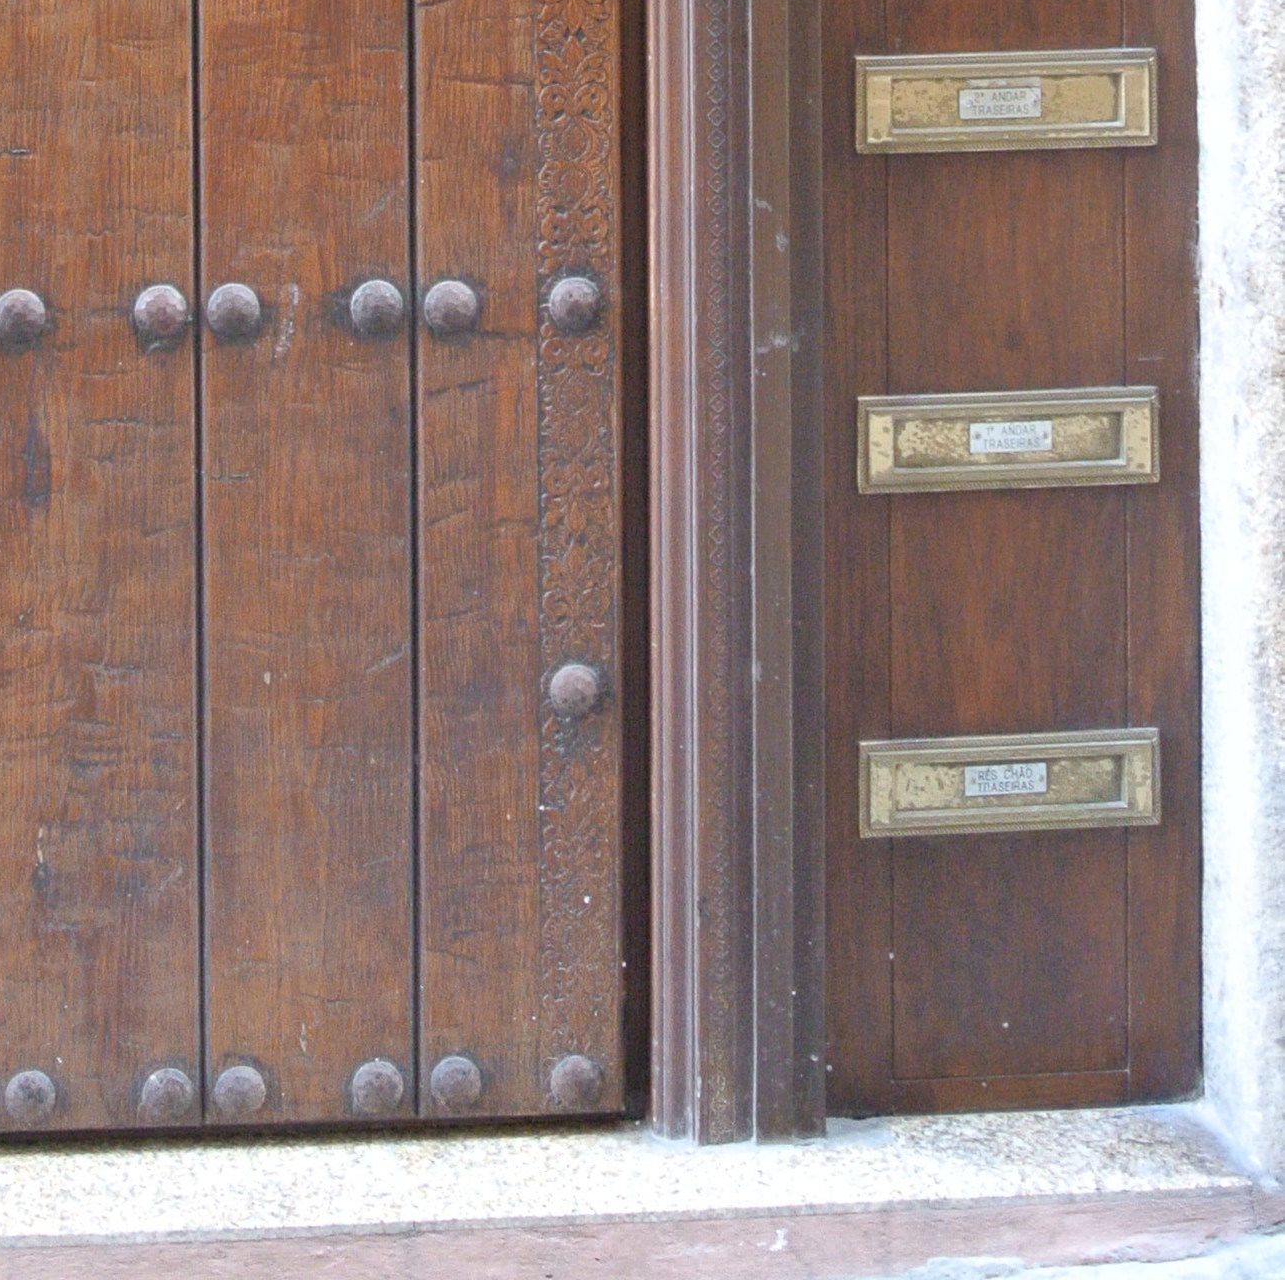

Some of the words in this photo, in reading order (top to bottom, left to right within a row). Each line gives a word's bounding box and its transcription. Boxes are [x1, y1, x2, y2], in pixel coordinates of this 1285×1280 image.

[992, 90, 1027, 102] ANDAR
[971, 104, 1029, 116] TRASEIRAS
[1001, 424, 1036, 435] ANDAR
[983, 437, 1041, 449] TRASEIRAS
